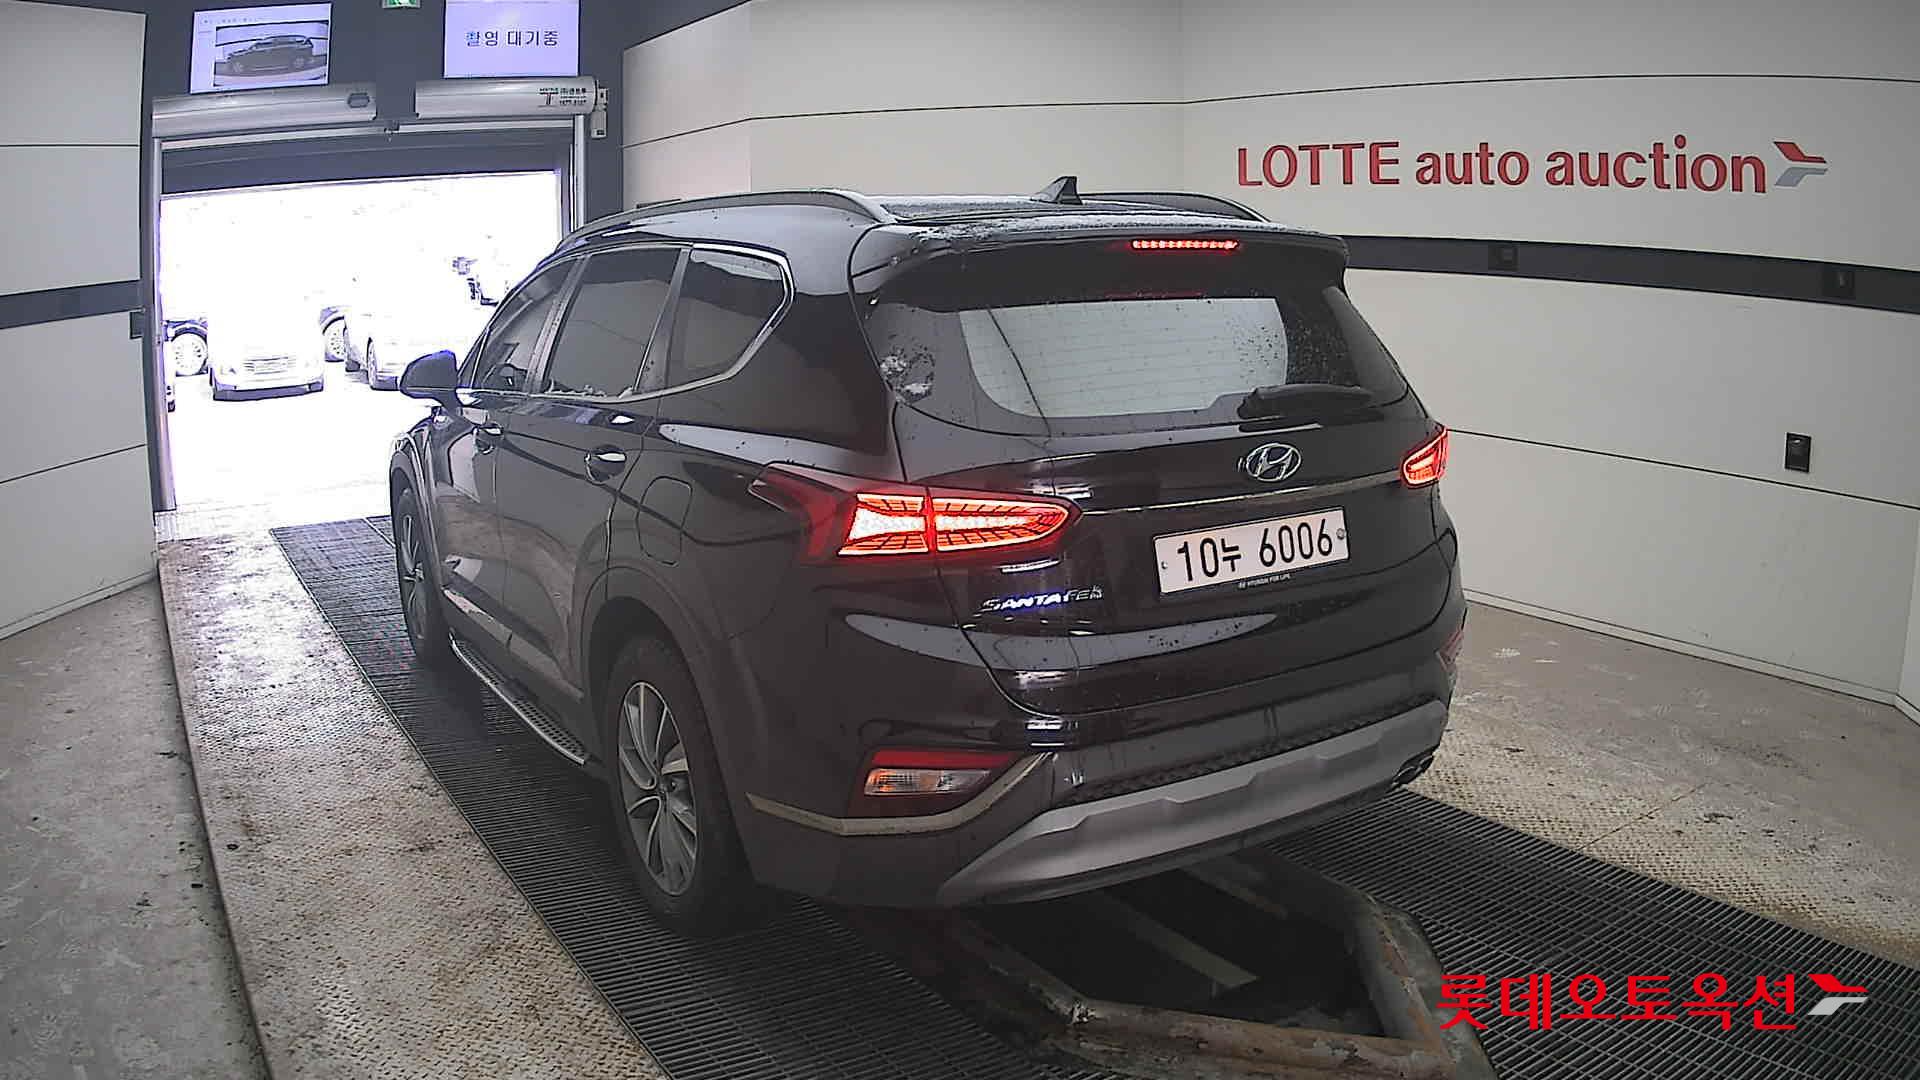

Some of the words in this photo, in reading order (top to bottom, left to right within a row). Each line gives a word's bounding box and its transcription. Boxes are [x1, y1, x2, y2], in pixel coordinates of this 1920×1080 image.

[507, 31, 558, 47] 대기중
[1237, 141, 1401, 187] LOTTE
[1415, 141, 1530, 187] auto
[1545, 134, 1767, 194] auction
[1177, 537, 1242, 582] 10누
[1259, 518, 1334, 568] 6006
